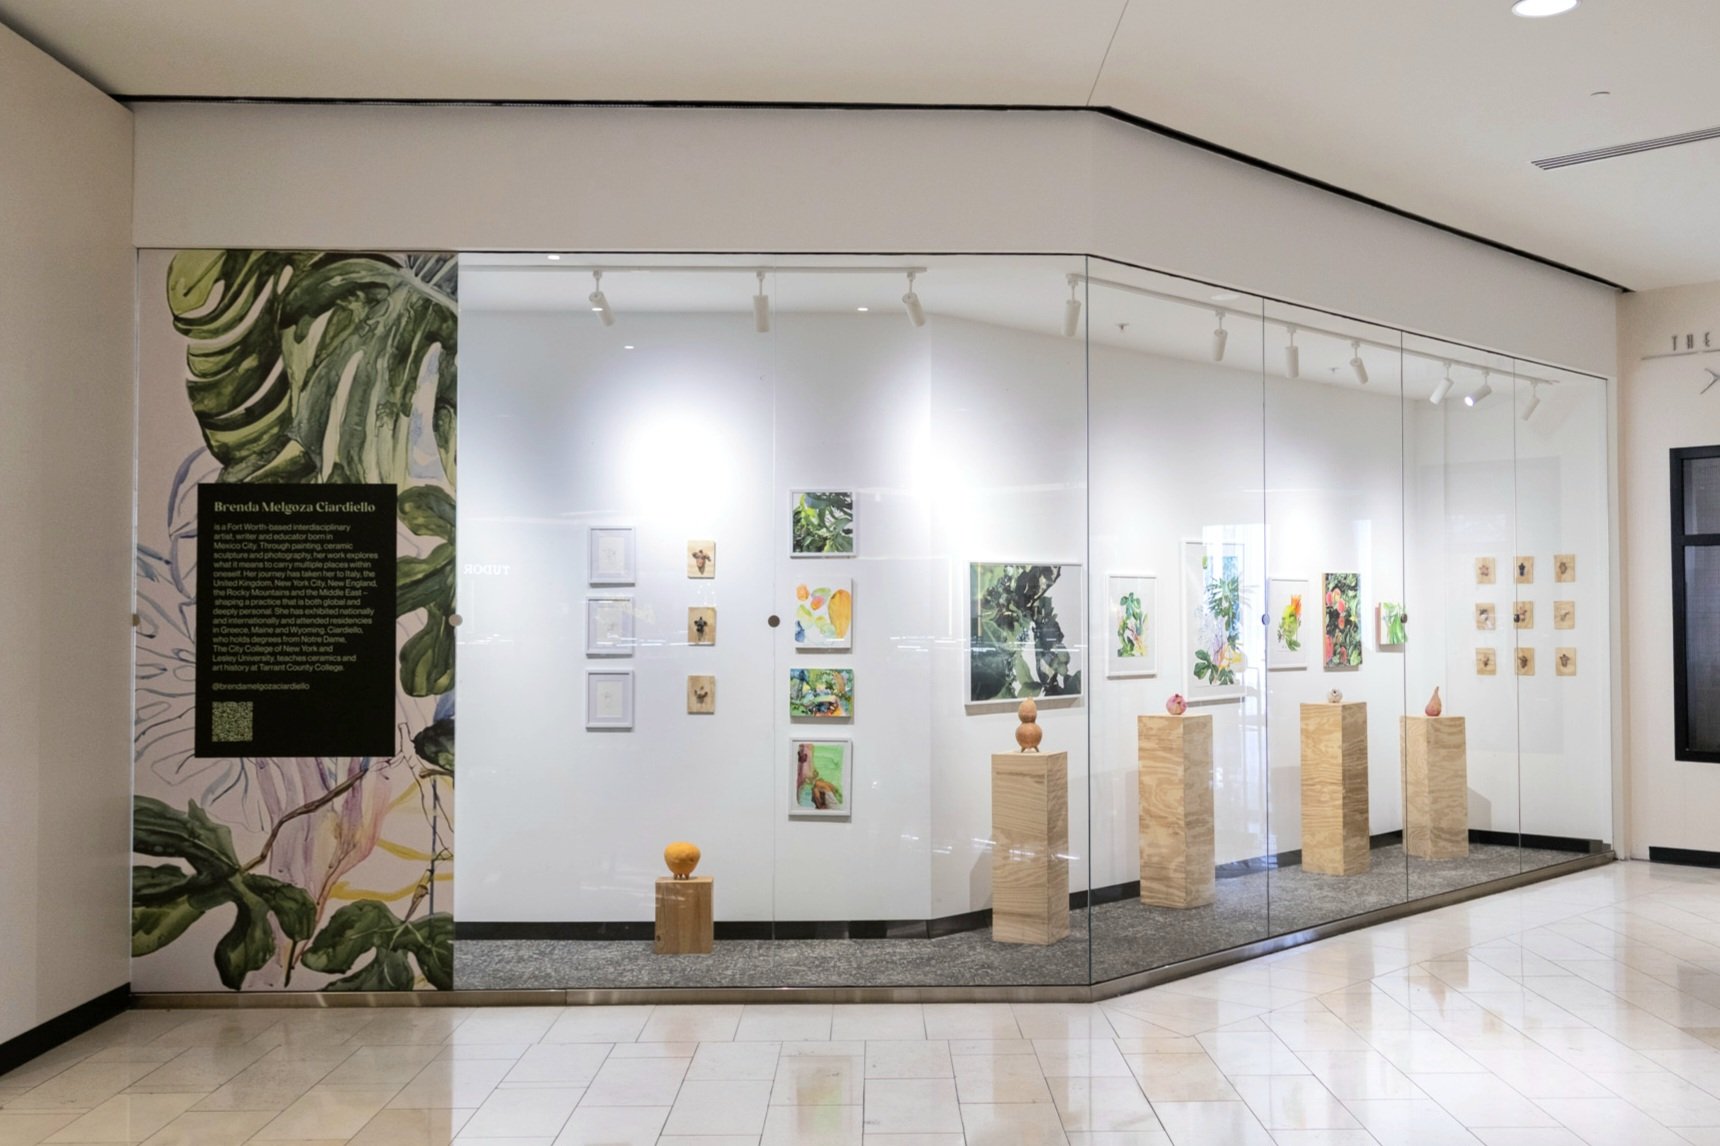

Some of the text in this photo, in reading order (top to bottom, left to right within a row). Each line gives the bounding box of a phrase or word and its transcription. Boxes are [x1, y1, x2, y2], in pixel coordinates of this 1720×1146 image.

[1672, 332, 1711, 351] THE
[214, 501, 376, 514] Brenda Melgoza Ciardiello
[227, 523, 243, 531] Fort
[243, 523, 292, 531] Worth-based
[293, 523, 351, 532] interdisciplinary
[236, 532, 257, 540] writer
[259, 532, 273, 540] and
[273, 532, 306, 540] educator
[308, 532, 325, 540] born
[260, 542, 291, 551] Through
[214, 552, 248, 560] sculpture
[346, 552, 378, 560] explores
[273, 562, 293, 570] carry
[294, 561, 323, 570] multiple
[324, 561, 348, 570] places
[258, 570, 286, 579] journey
[213, 579, 238, 587] United
[275, 579, 291, 587] New
[292, 579, 309, 587] York
[327, 579, 345, 587] New
[226, 589, 251, 597] Rocky
[215, 598, 244, 607] shaping
[250, 598, 281, 607] practice
[323, 598, 345, 607] global
[213, 608, 238, 616] deeply
[339, 608, 375, 616] nationally
[228, 617, 280, 626] internationally
[251, 626, 274, 634] Maine
[275, 626, 289, 634] and
[251, 636, 282, 644] degrees
[228, 645, 244, 654] City
[245, 645, 273, 654] College
[212, 654, 237, 663] Lesley
[224, 664, 250, 673] history
[286, 664, 314, 673] County
